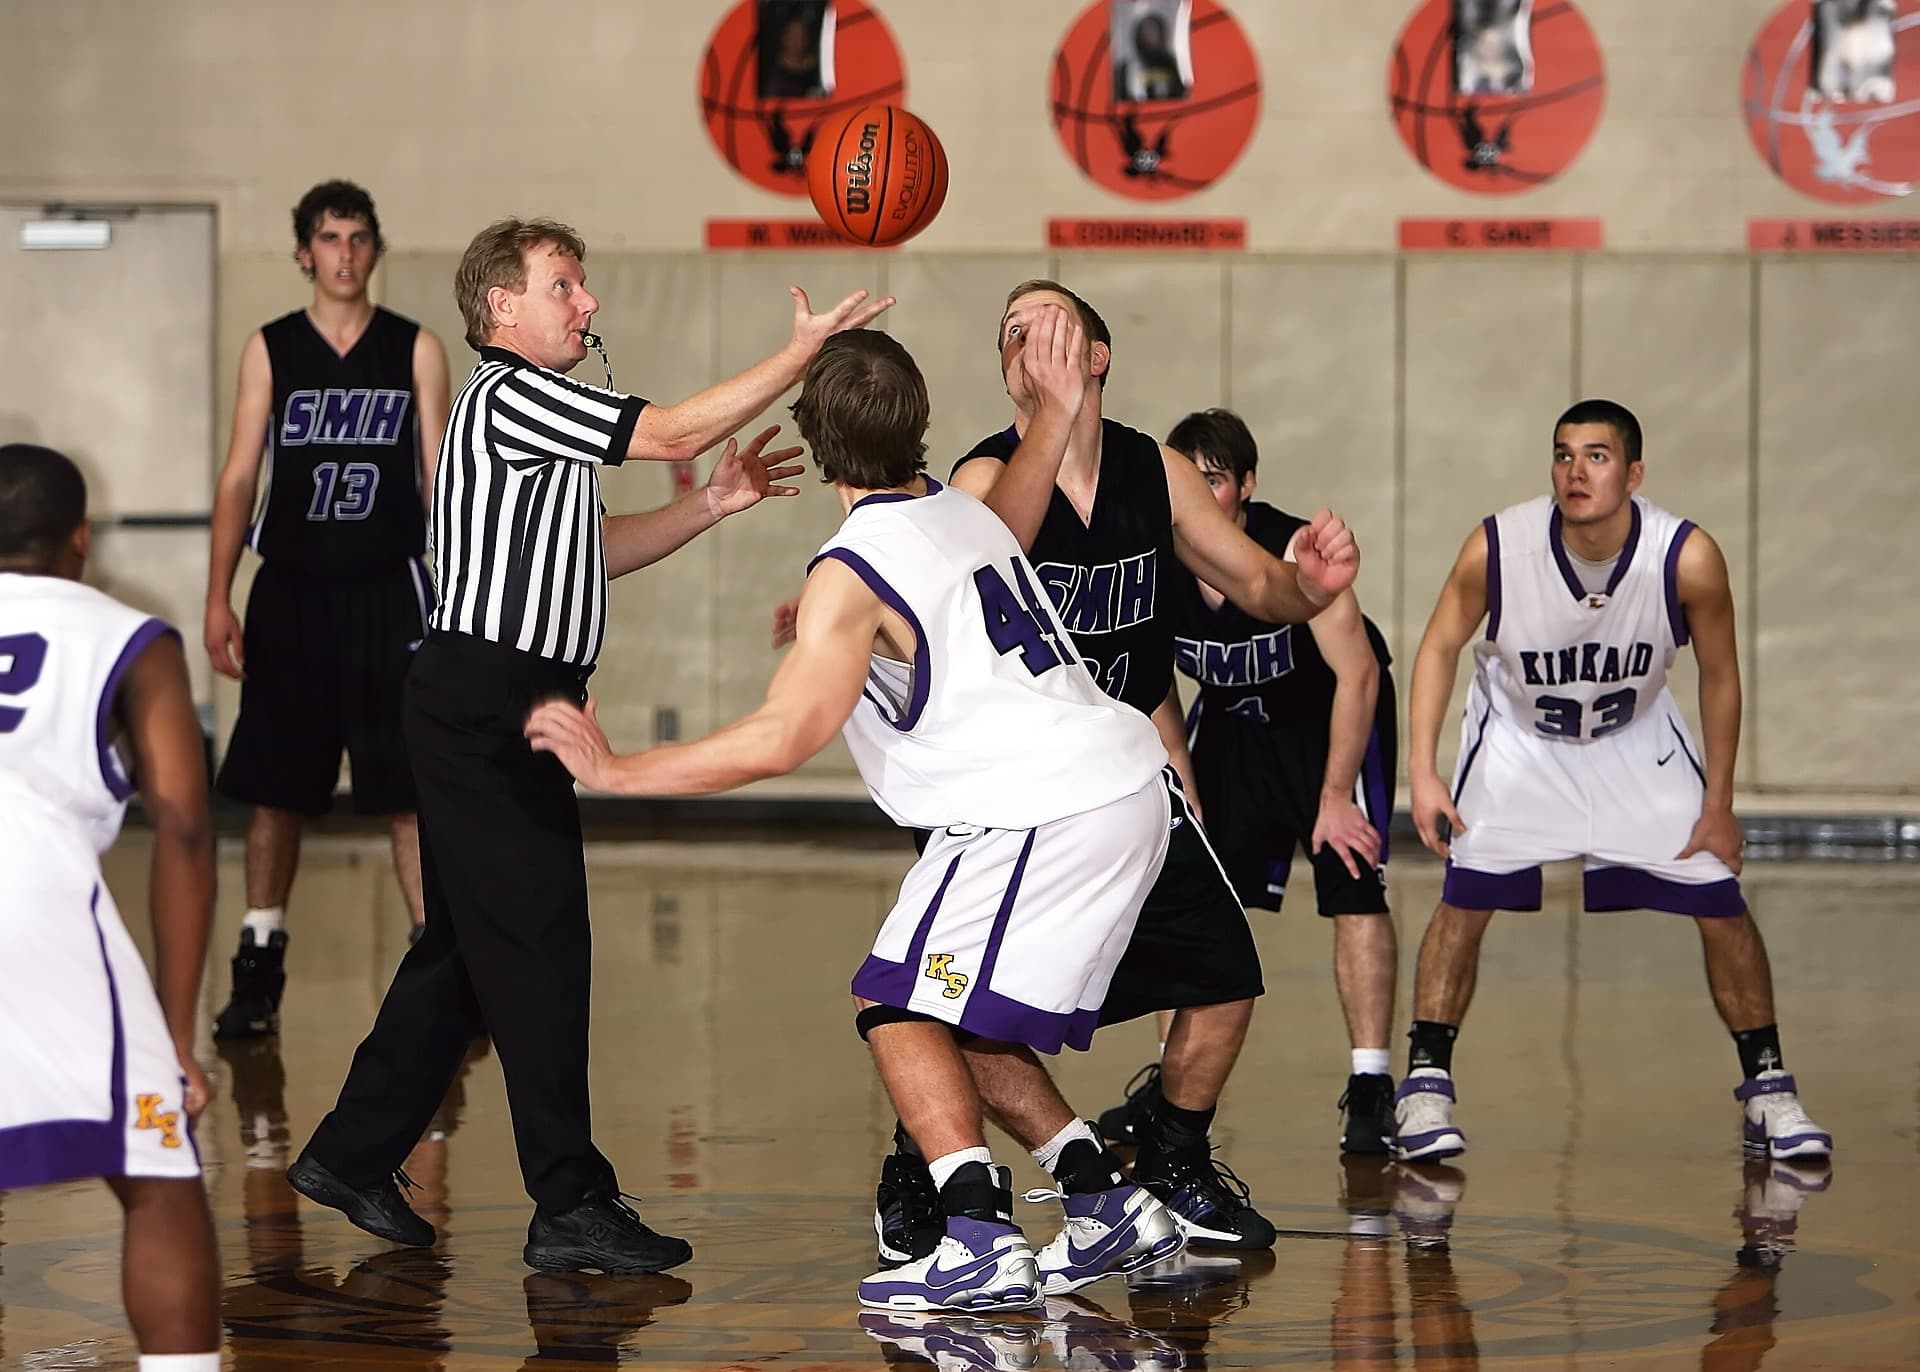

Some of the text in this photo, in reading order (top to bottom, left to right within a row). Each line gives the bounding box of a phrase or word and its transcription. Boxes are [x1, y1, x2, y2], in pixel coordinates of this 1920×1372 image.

[846, 122, 880, 214] Wilson
[892, 129, 919, 220] EVOLUTION
[279, 387, 411, 446] SMH
[306, 461, 380, 521] 13
[1033, 547, 1157, 635] SMH
[1174, 623, 1295, 686] SMH
[1520, 641, 1653, 686] KINKAID
[1535, 686, 1637, 738] 33
[924, 953, 969, 999] KS
